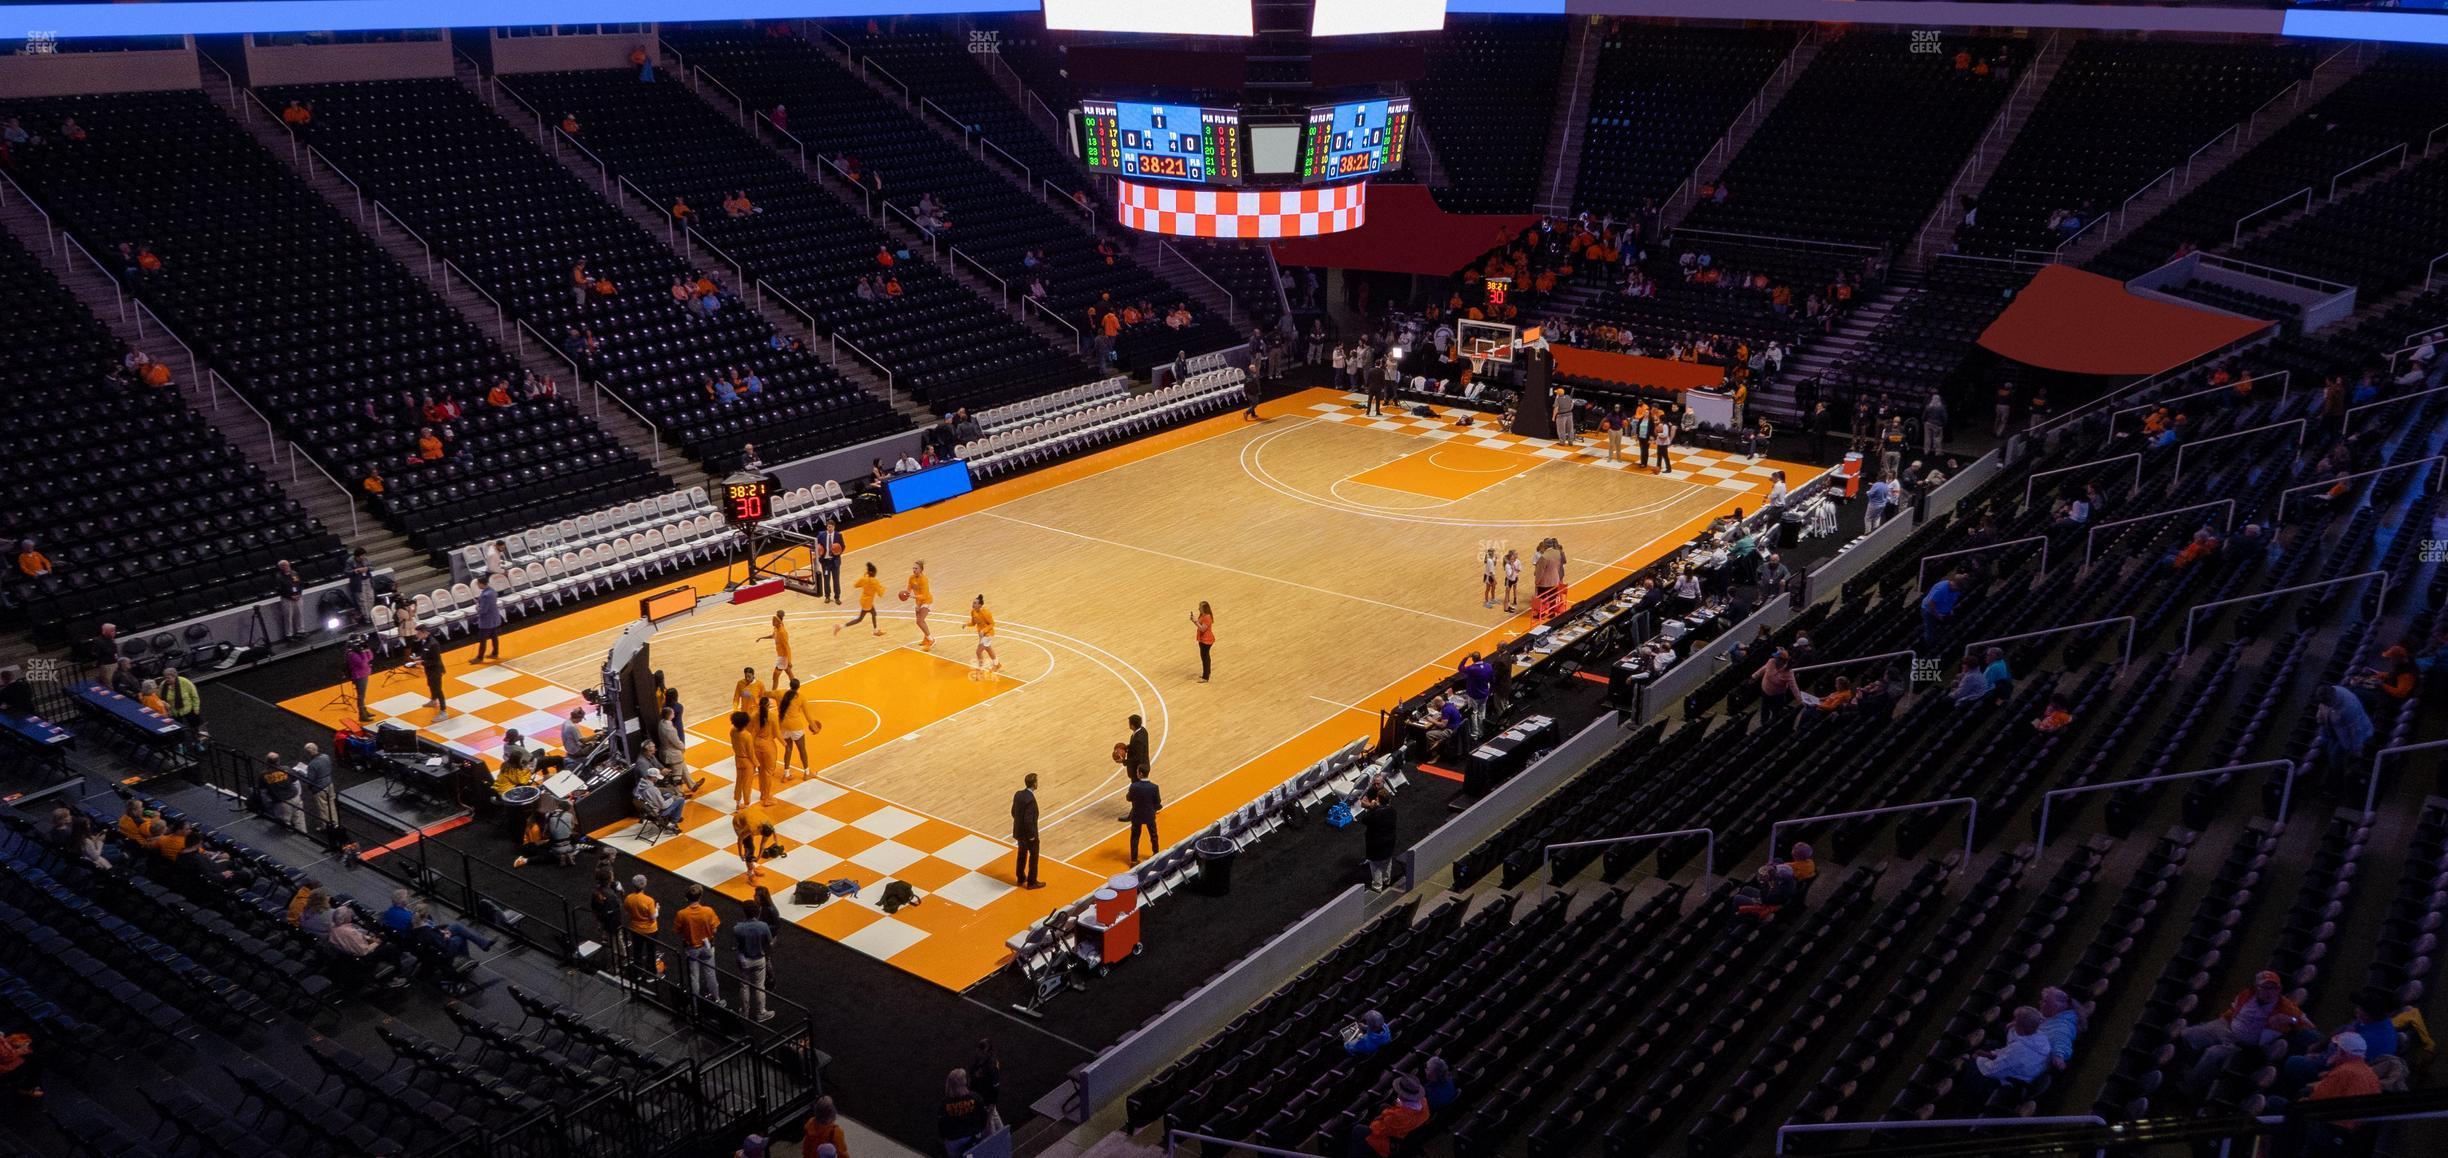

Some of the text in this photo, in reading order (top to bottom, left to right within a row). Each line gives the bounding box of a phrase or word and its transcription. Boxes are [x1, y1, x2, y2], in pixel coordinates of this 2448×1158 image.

[1085, 117, 1116, 128] 00 1 9
[1157, 116, 1162, 128] 1
[1358, 114, 1362, 126] 1
[1090, 128, 1094, 136] 1
[1109, 129, 1118, 138] 17
[1206, 126, 1235, 136] 3 0 0
[1128, 133, 1136, 146] 0
[1205, 136, 1236, 146] 11 0 7
[1363, 138, 1368, 146] 4
[1374, 130, 1379, 144] 0
[1088, 138, 1117, 148] 13 1 8
[1146, 140, 1152, 149] 4
[1170, 142, 1176, 151] 4
[1186, 138, 1194, 151] 0
[1336, 136, 1342, 149] 0
[1348, 140, 1352, 148] 4
[1088, 148, 1120, 158] 23 1 10
[1204, 147, 1236, 157] 20 2 7
[1089, 158, 1118, 168] 33 0 0
[1128, 162, 1134, 172] 0
[1140, 156, 1186, 176] 38:21
[1206, 158, 1237, 168] 21 1 2
[1340, 153, 1370, 174] 38:21
[1372, 160, 1376, 169] 0
[1192, 168, 1198, 178] 0
[1206, 168, 1238, 178] 24 0 0
[1330, 166, 1336, 176] 0
[1488, 282, 1507, 290] 38:21
[1490, 290, 1504, 304] 30
[730, 484, 764, 498] 38:21
[736, 496, 762, 518] 30
